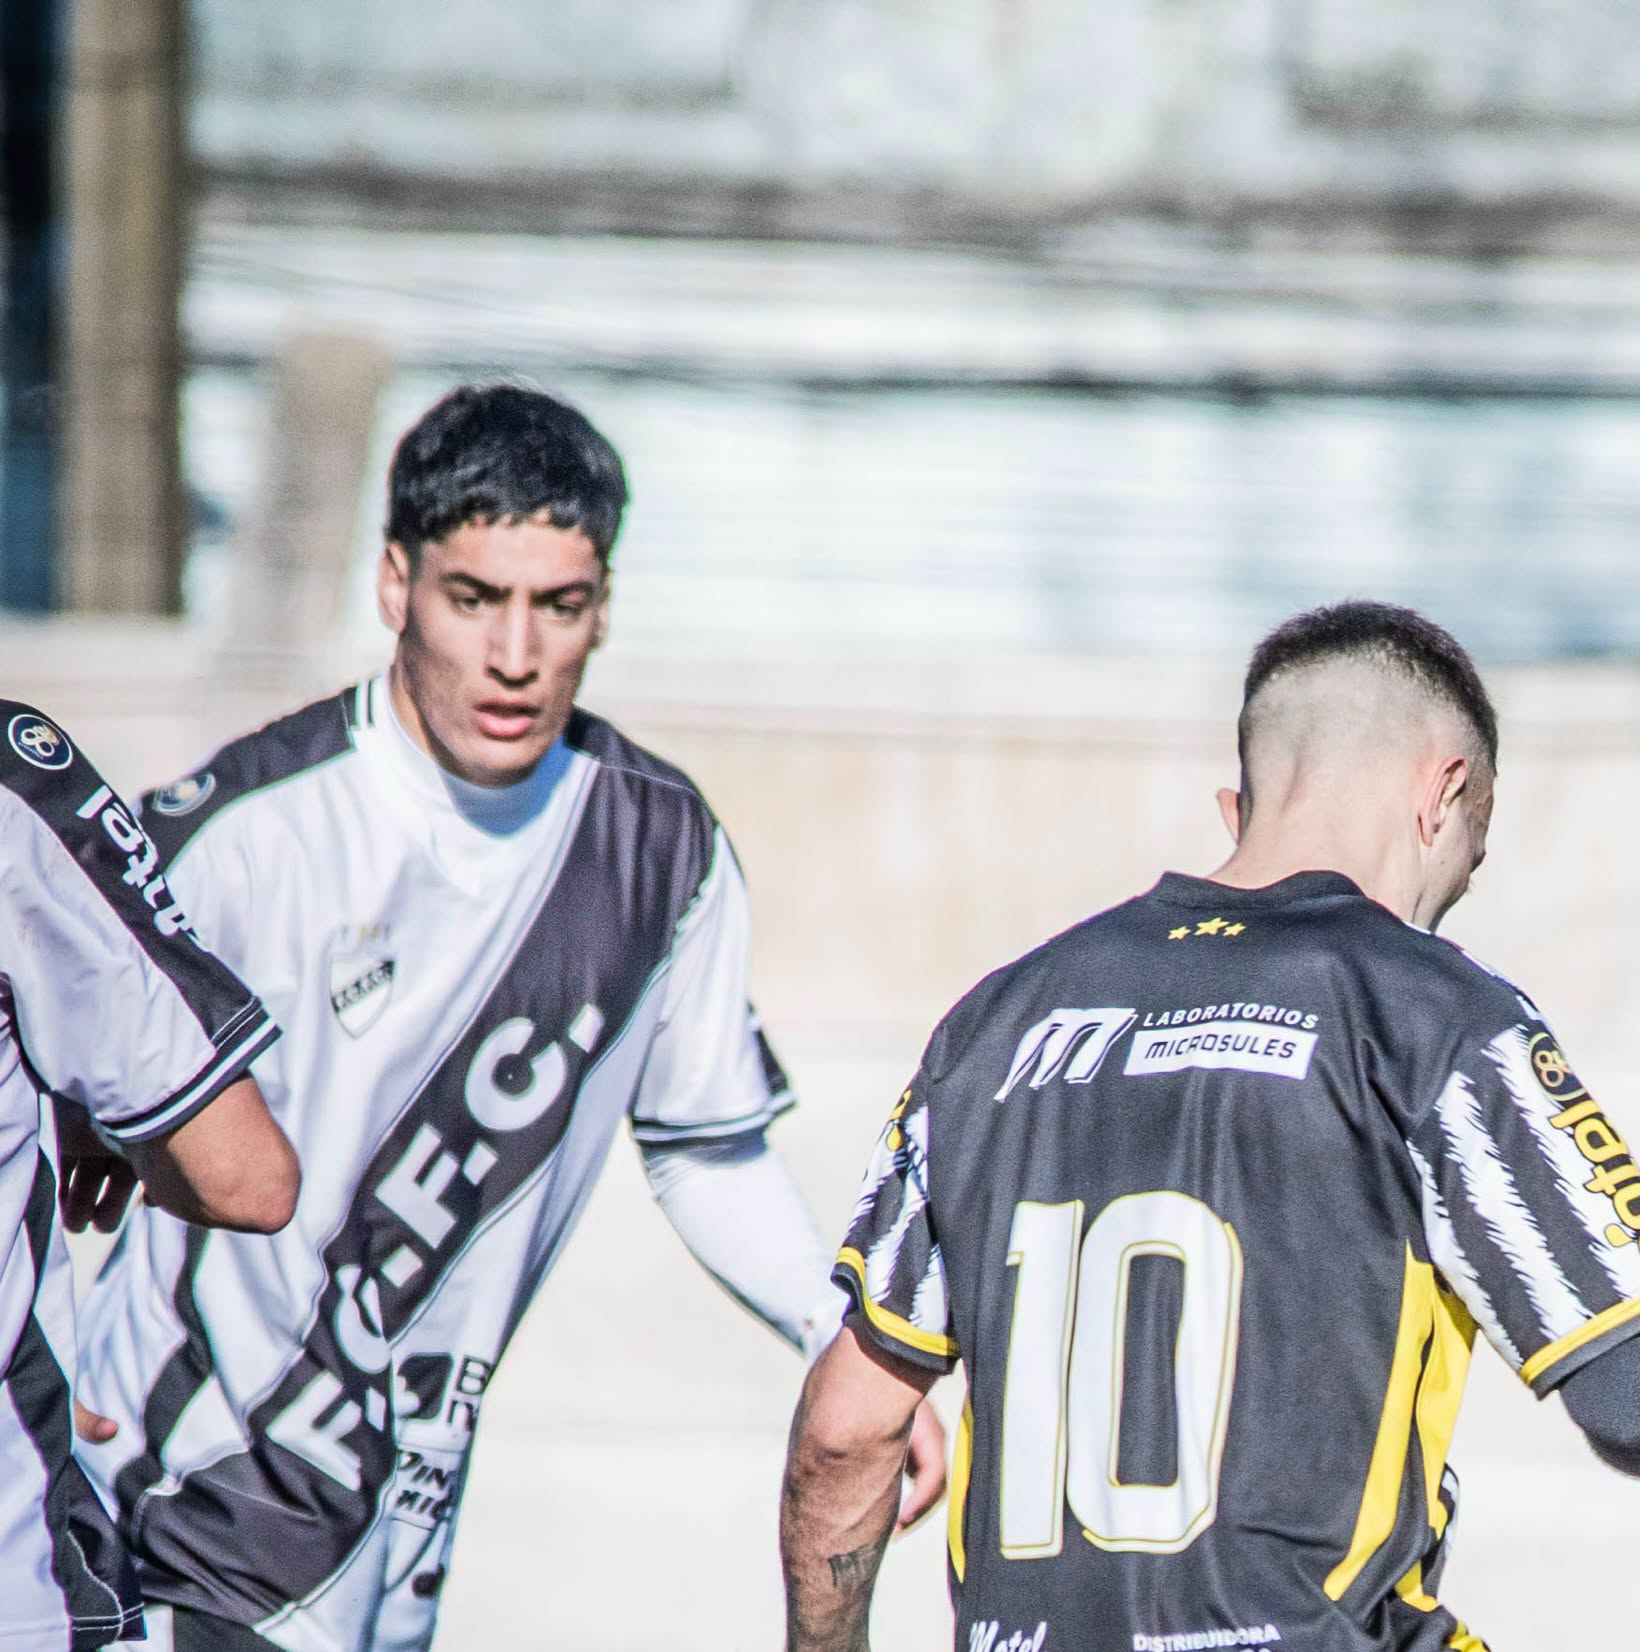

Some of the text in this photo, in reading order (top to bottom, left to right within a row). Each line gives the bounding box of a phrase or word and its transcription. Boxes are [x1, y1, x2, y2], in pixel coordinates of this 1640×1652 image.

[1142, 1002, 1319, 1030] LABORATORIOS
[1144, 1033, 1297, 1060] MICROSULES
[1000, 1190, 1243, 1561] 10
[1132, 1624, 1281, 1652] DISTRIBUIDORA
